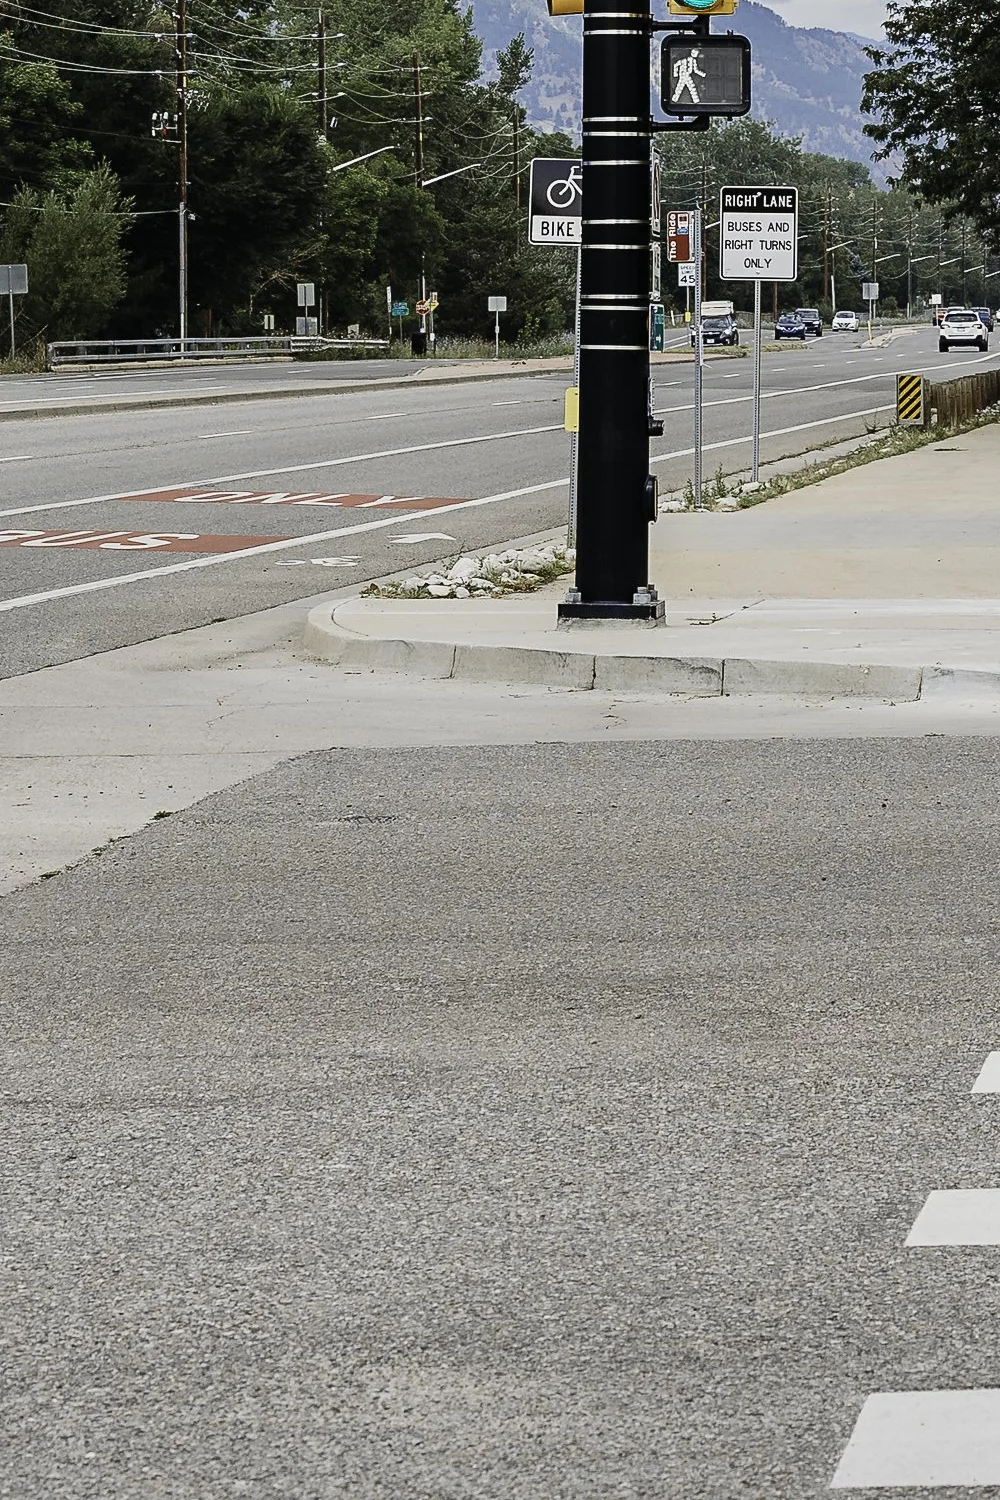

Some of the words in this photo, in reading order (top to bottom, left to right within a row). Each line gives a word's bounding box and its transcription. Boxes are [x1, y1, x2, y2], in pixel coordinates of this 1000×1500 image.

[725, 194, 758, 207] RIGHT
[763, 195, 793, 207] LANE
[541, 220, 575, 237] BIKE
[727, 221, 762, 232] BUSES
[767, 222, 790, 232] AND
[724, 240, 753, 250] RIGHT
[759, 240, 792, 251] TURNS
[743, 257, 772, 269] ONLY
[680, 274, 696, 284] 45
[174, 491, 425, 508] ONLY
